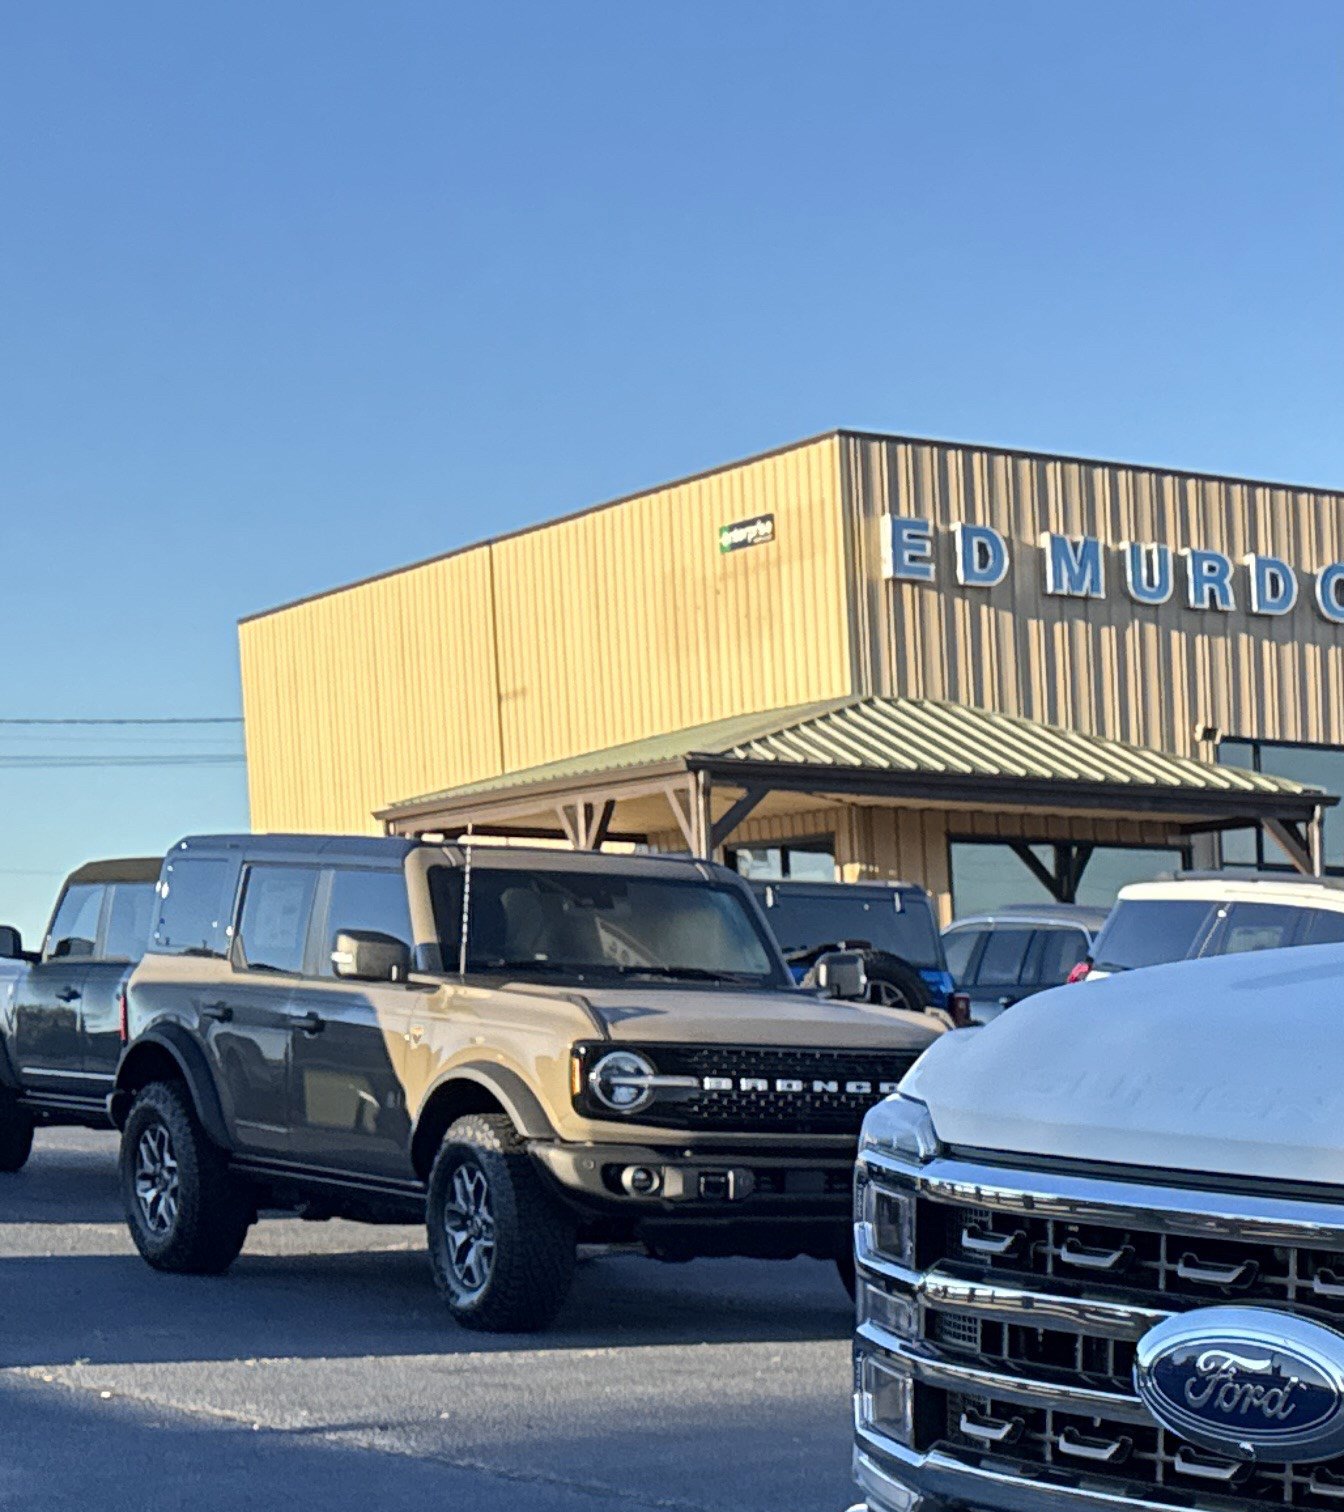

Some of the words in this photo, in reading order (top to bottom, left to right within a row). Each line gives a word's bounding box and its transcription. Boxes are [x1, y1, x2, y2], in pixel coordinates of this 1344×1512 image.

[880, 513, 1010, 587] ED
[703, 1076, 900, 1094] BRONCO
[1184, 1349, 1297, 1421] Ford
